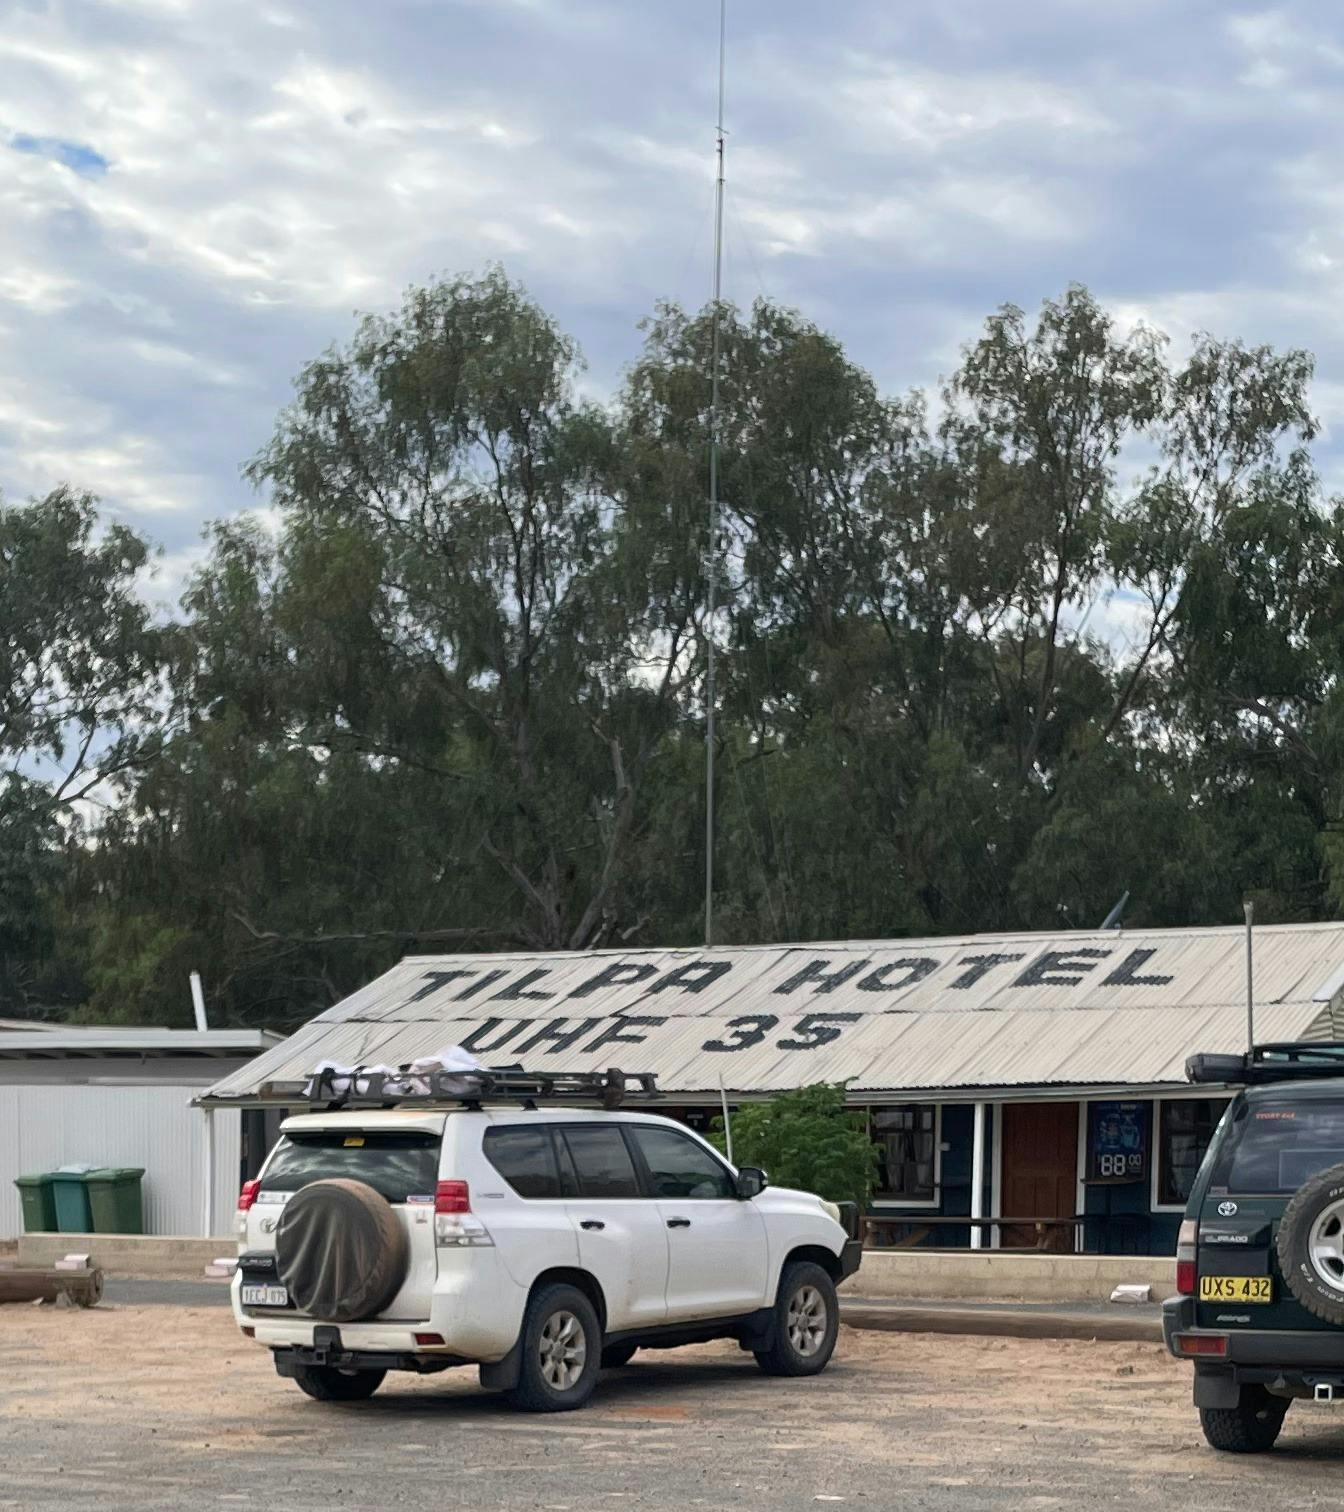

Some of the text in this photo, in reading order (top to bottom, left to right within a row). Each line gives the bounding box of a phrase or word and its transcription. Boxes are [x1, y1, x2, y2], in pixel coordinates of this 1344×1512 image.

[408, 948, 1173, 1001] TILPA HOTEL
[457, 1012, 863, 1055] UHF 35
[1202, 1278, 1269, 1297] UXS 432
